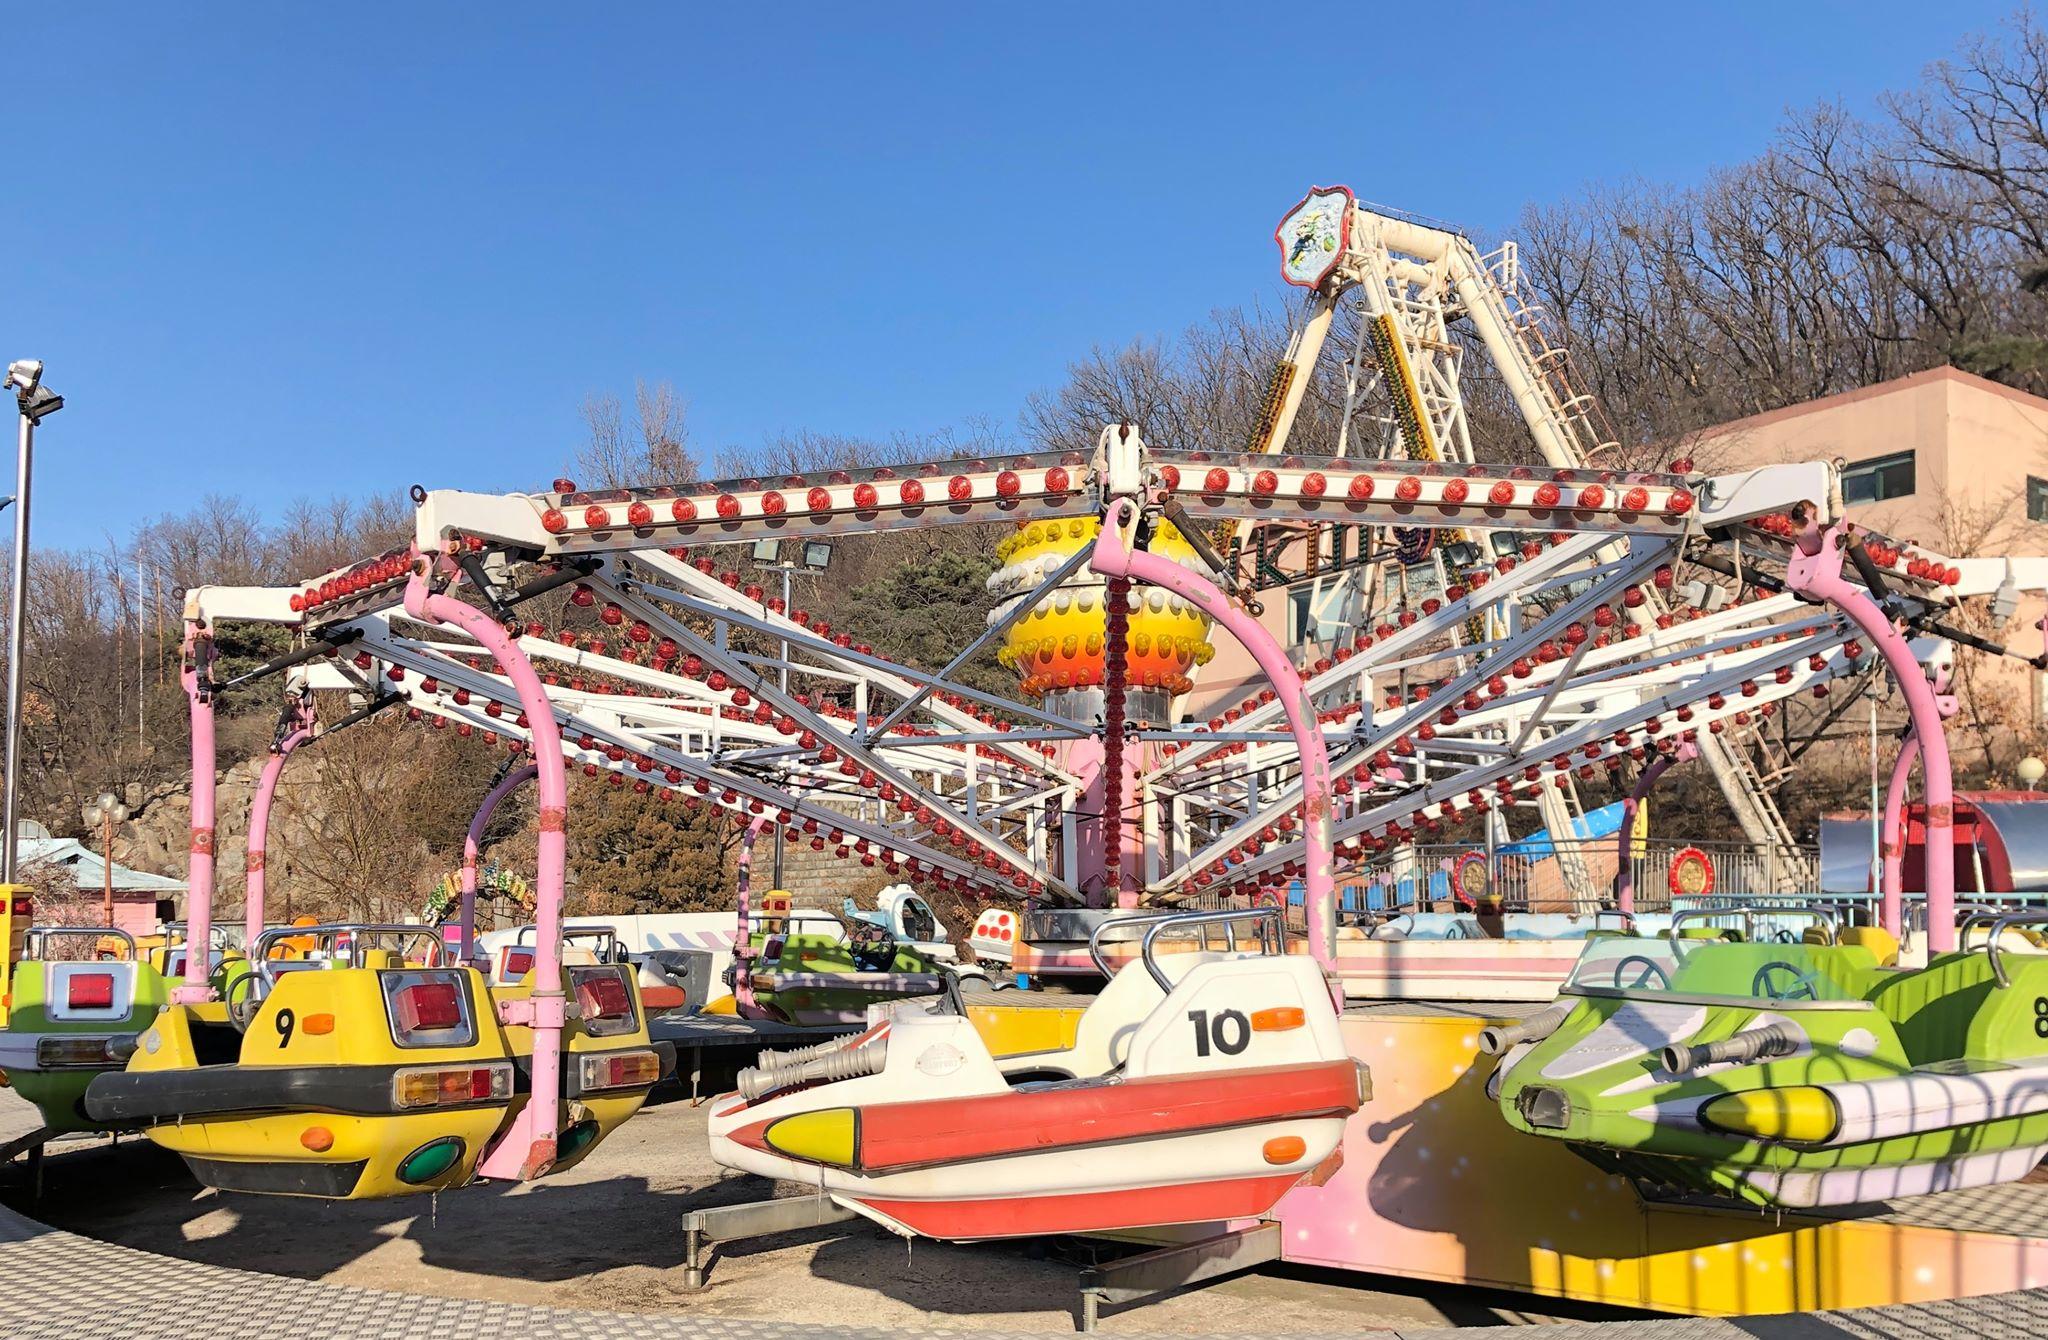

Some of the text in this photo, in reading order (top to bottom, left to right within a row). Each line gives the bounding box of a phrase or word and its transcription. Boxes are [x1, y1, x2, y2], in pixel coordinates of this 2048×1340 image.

[276, 1008, 295, 1048] 9
[1188, 1008, 1250, 1057] 10
[2034, 996, 2048, 1038] 8
